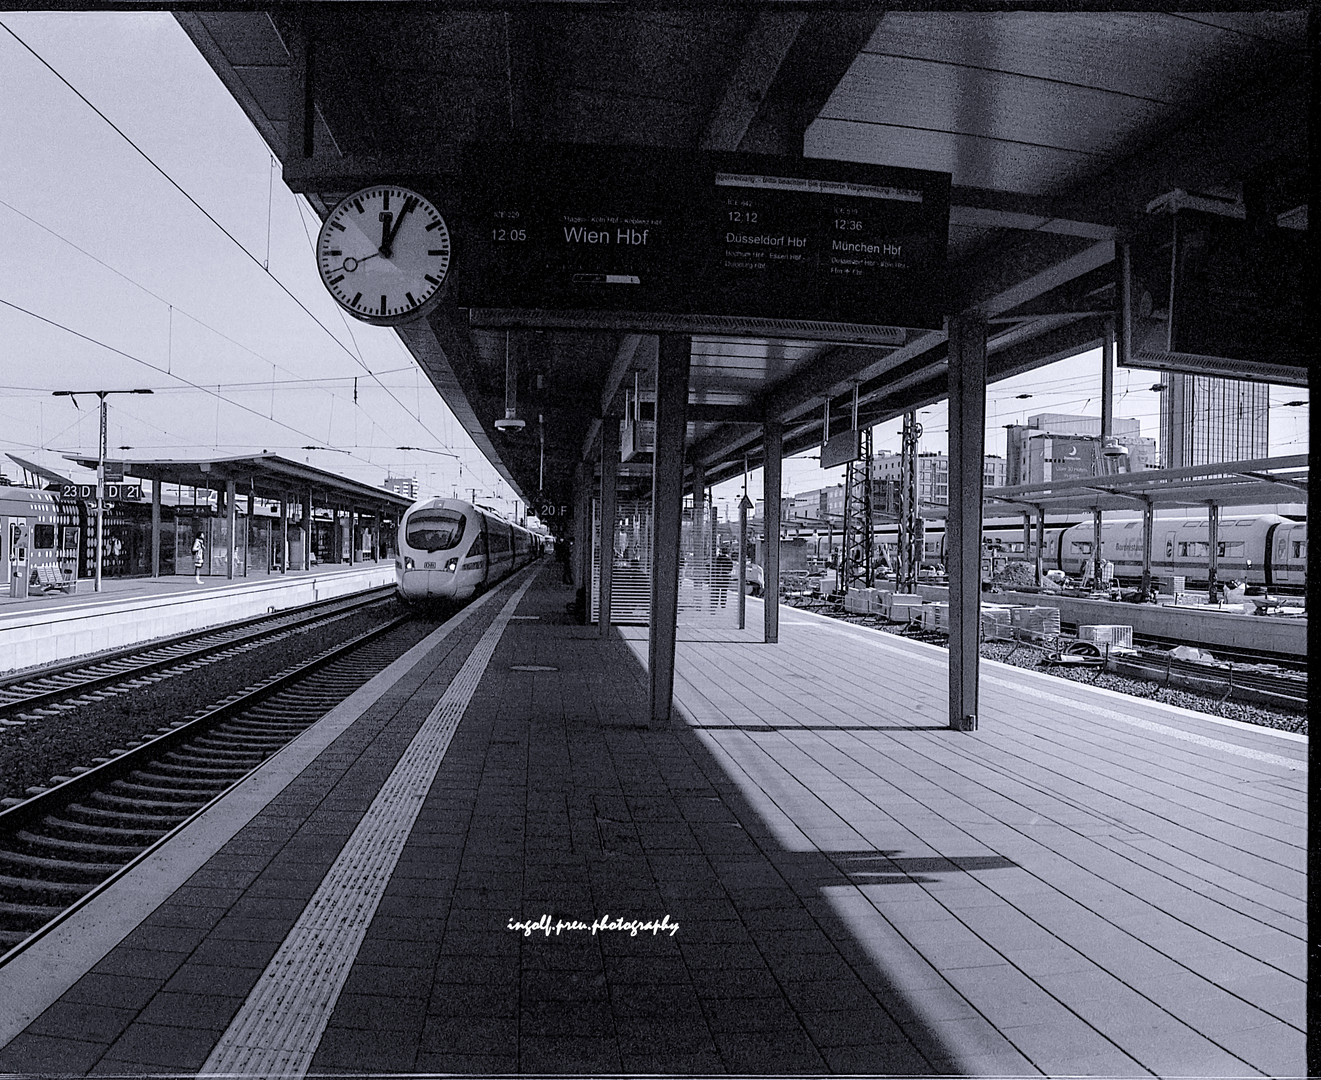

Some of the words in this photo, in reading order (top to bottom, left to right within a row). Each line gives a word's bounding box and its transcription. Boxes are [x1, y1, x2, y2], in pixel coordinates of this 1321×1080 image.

[728, 211, 758, 223] 12:12
[835, 219, 863, 231] 12:36
[491, 229, 527, 241] 12:05
[564, 226, 610, 244] Wien
[617, 229, 649, 245] Hbf
[726, 232, 784, 247] Düsseldorf
[787, 236, 807, 248] Hbf
[832, 239, 880, 254] München
[883, 244, 902, 256] Hbf
[63, 485, 77, 497] 23
[81, 485, 91, 498] D
[109, 486, 118, 498] D
[127, 486, 139, 498] 21
[541, 504, 556, 516] 20
[560, 505, 568, 516] F
